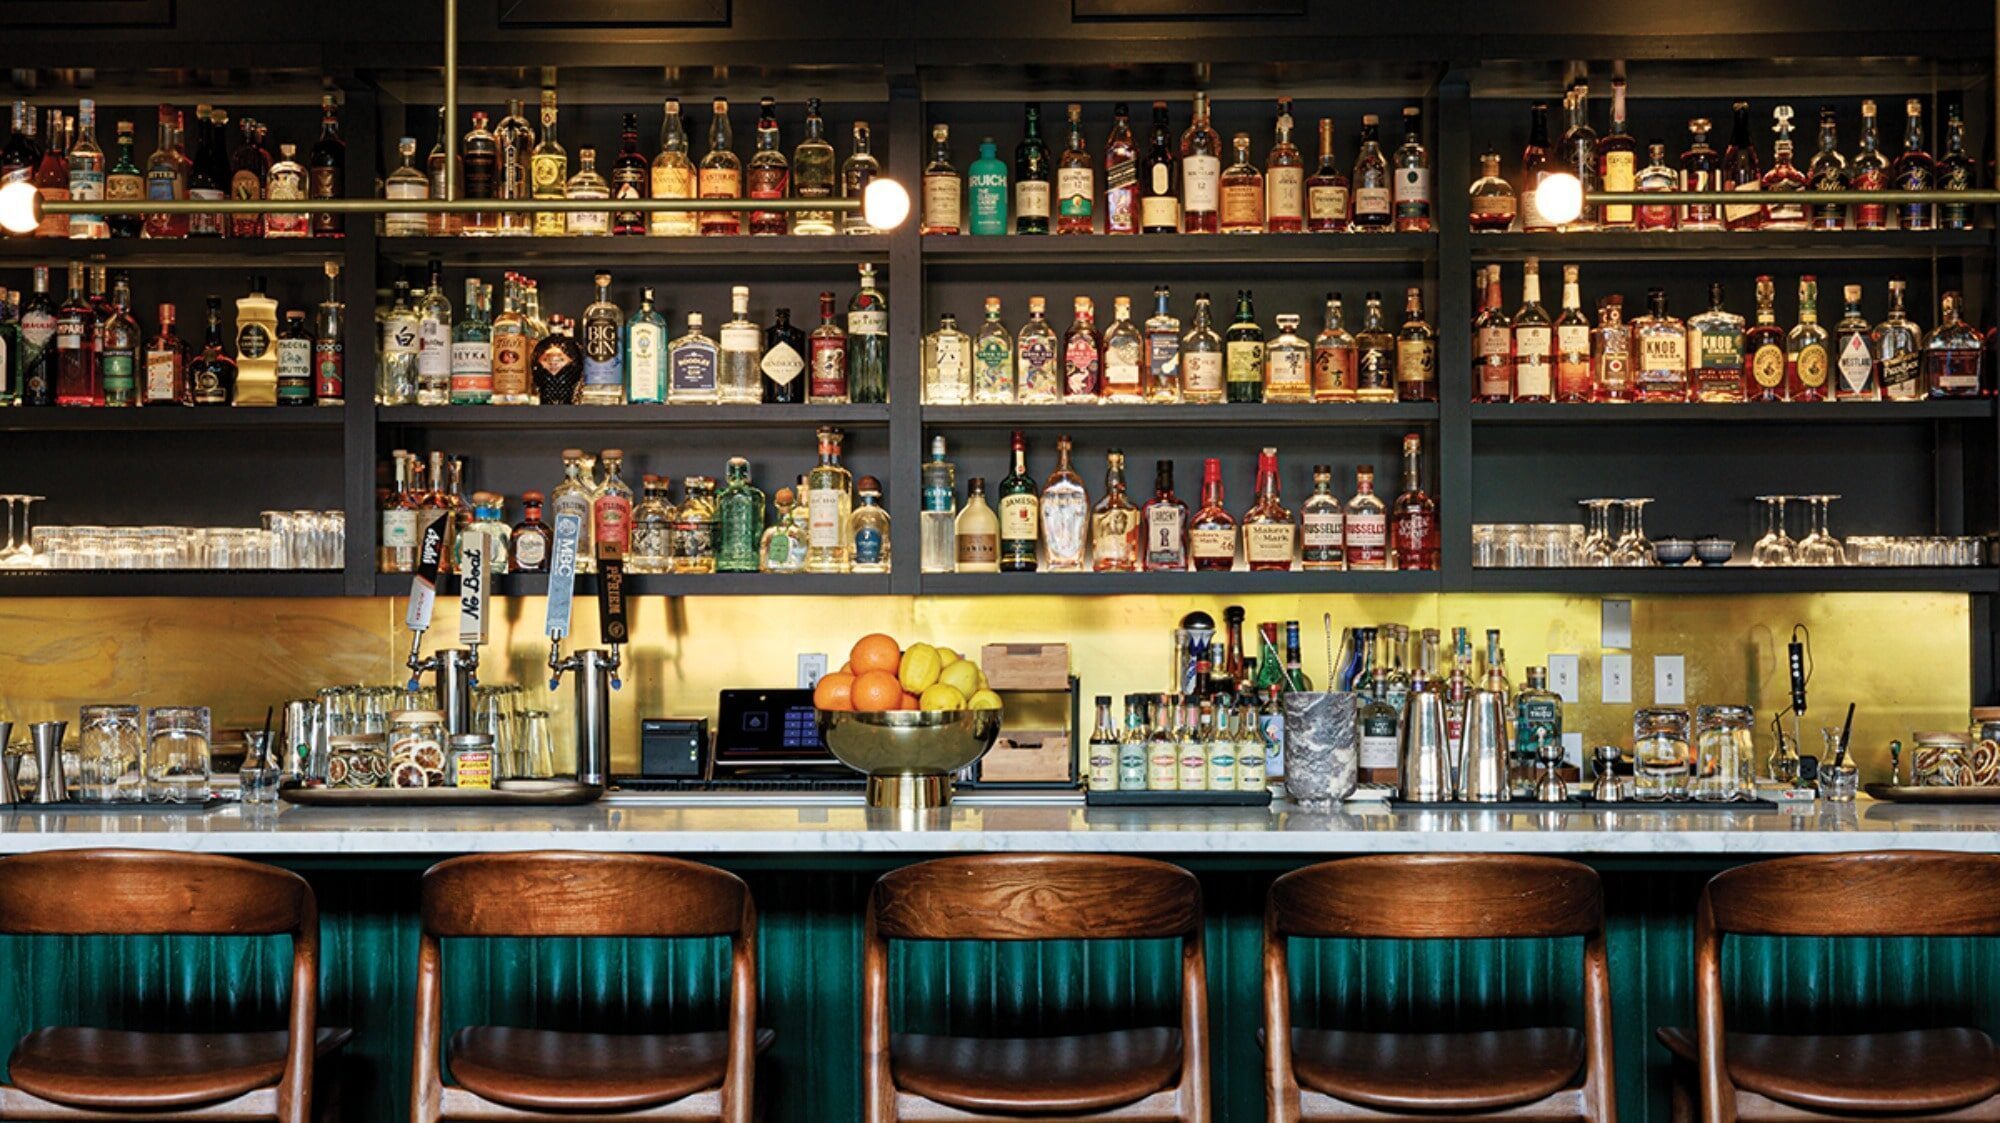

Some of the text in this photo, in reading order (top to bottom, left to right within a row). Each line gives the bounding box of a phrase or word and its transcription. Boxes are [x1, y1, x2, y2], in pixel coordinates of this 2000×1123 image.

[57, 324, 84, 336] MPARI
[588, 325, 616, 341] BIG
[587, 341, 616, 356] GIN
[1646, 341, 1677, 354] KNOB
[1702, 336, 1733, 349] KNOB
[1254, 526, 1290, 534] Maker's
[1263, 534, 1289, 542] Mark
[558, 538, 574, 577] MBC
[461, 549, 481, 620] No Boat
